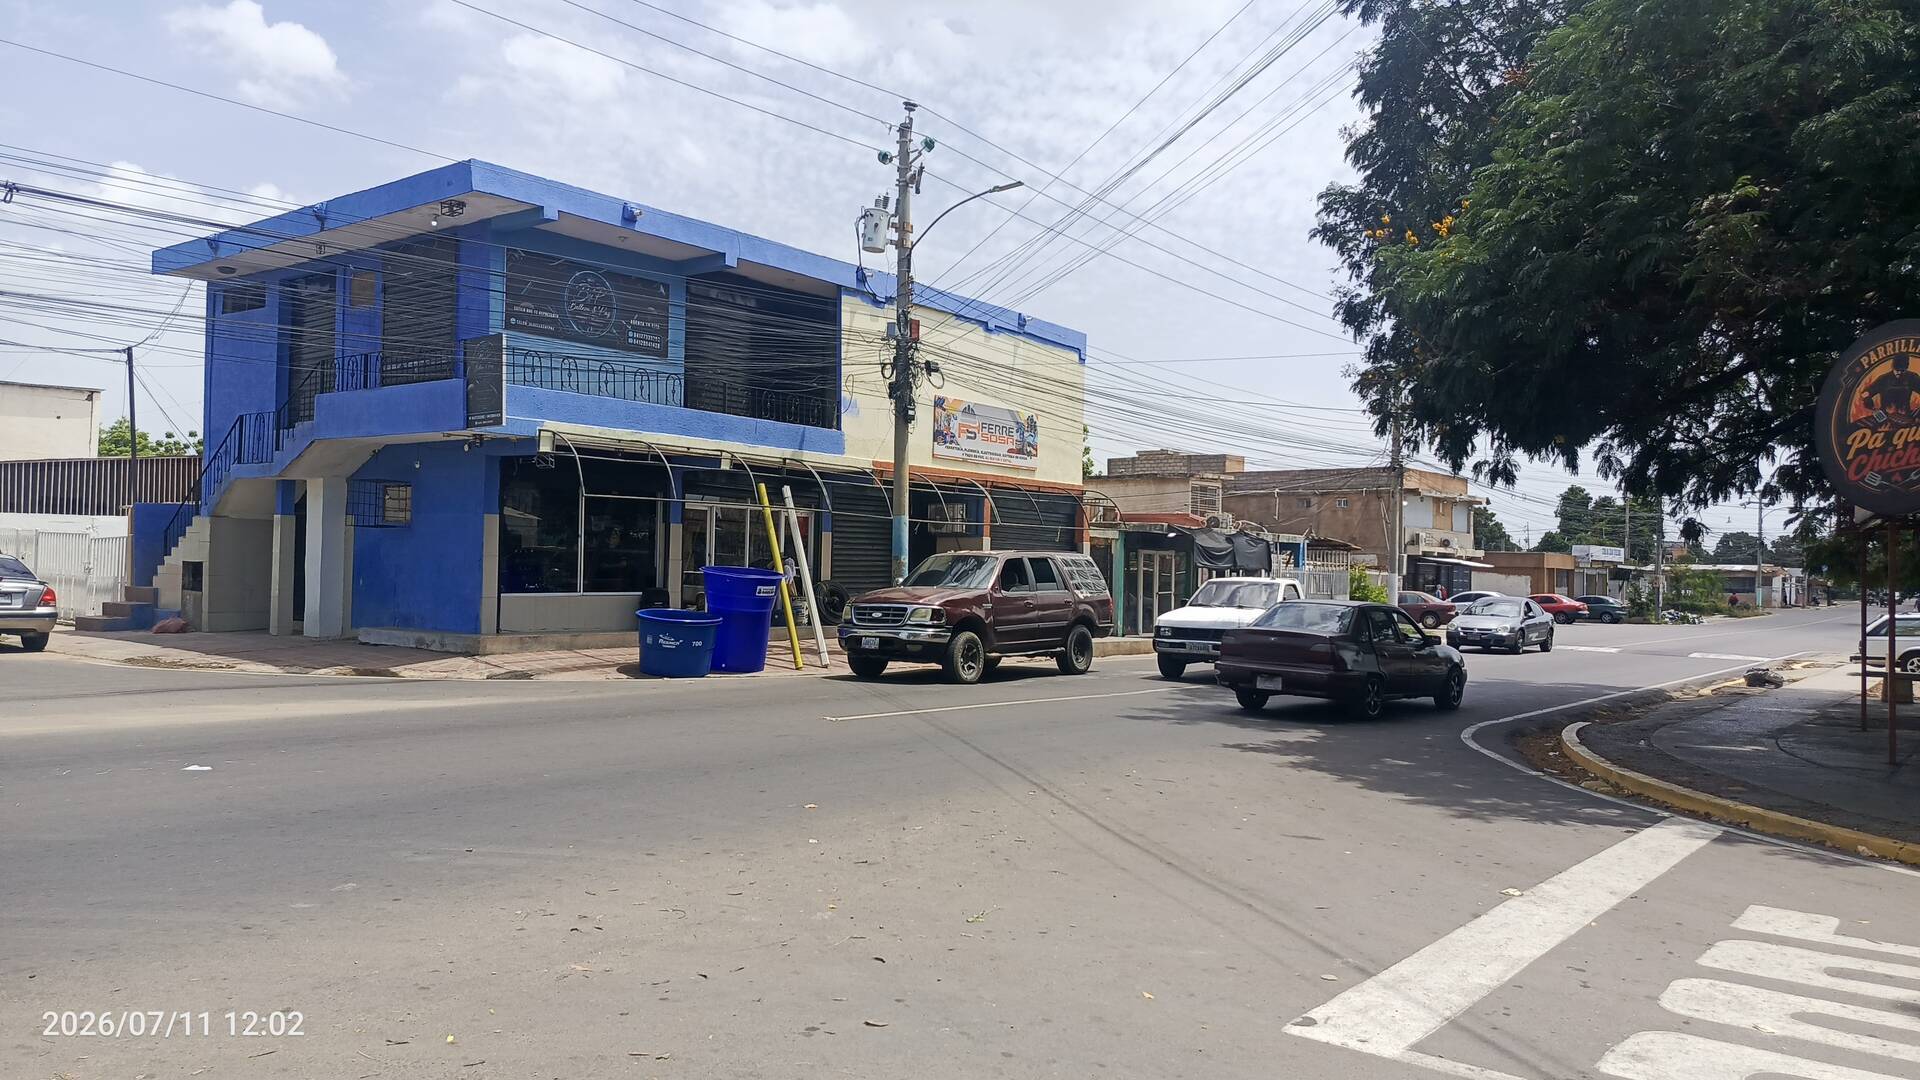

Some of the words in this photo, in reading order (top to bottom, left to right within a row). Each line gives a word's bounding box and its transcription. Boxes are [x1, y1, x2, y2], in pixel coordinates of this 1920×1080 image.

[1860, 338, 1920, 369] PARRILL
[981, 422, 1015, 437] FERRE
[981, 433, 1015, 446] SOSA
